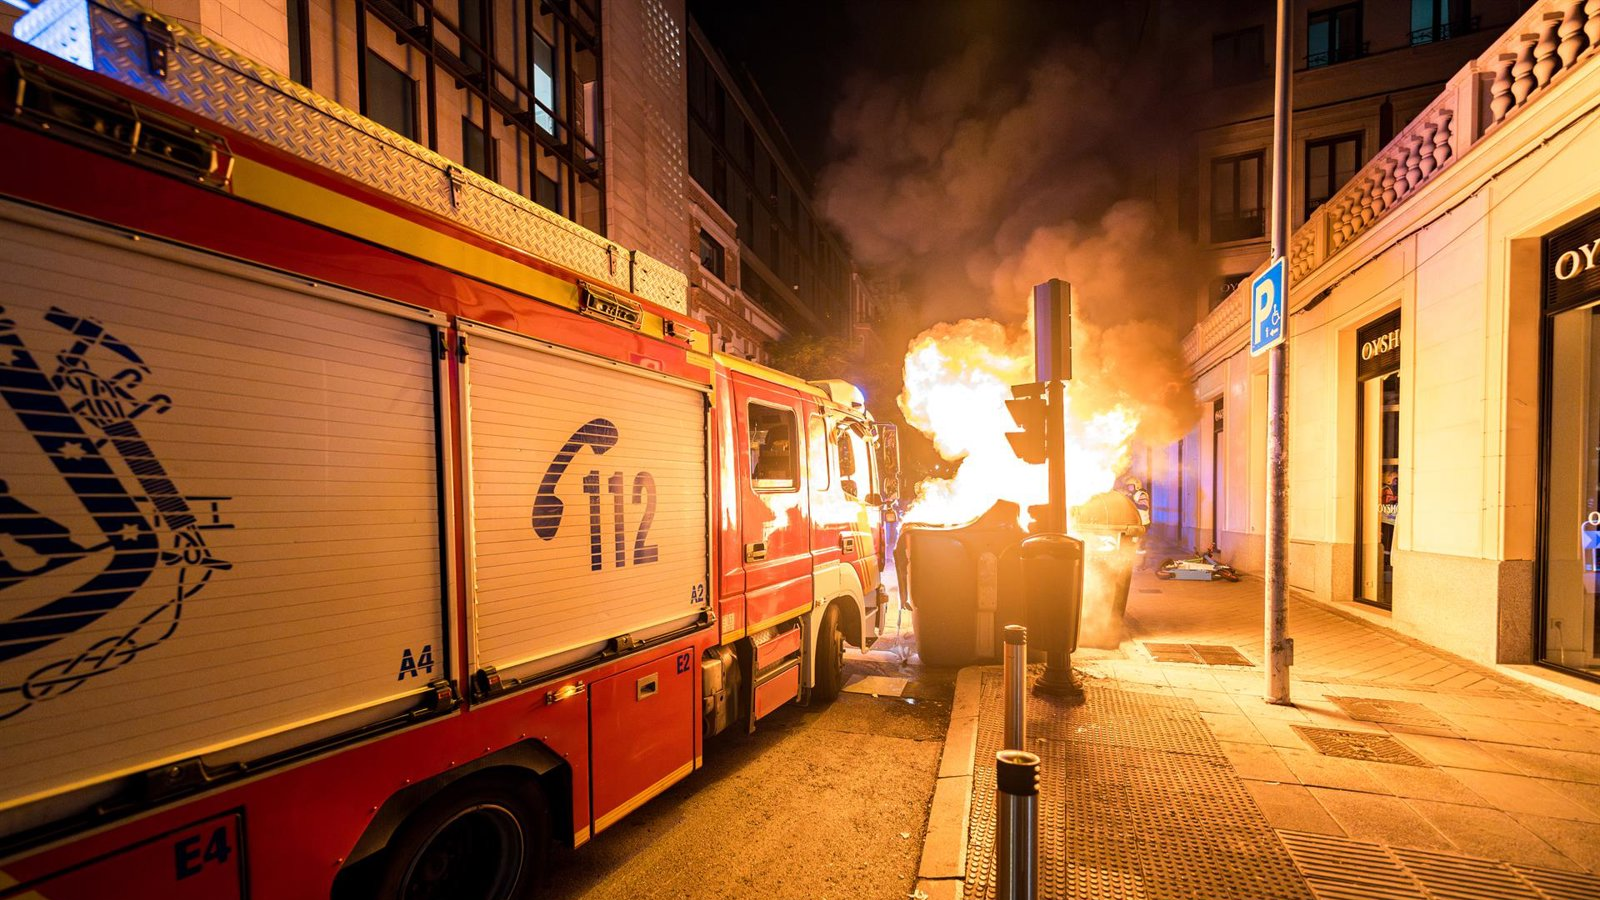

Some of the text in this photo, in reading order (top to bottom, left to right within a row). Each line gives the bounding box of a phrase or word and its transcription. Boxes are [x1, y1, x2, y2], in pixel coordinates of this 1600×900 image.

[1555, 238, 1600, 280] OY
[1254, 279, 1275, 345] P
[1361, 328, 1401, 361] OYSH
[582, 470, 659, 572] 112
[690, 583, 704, 605] A2
[397, 644, 435, 681] A4
[677, 652, 690, 674] E2
[174, 826, 231, 881] E4
